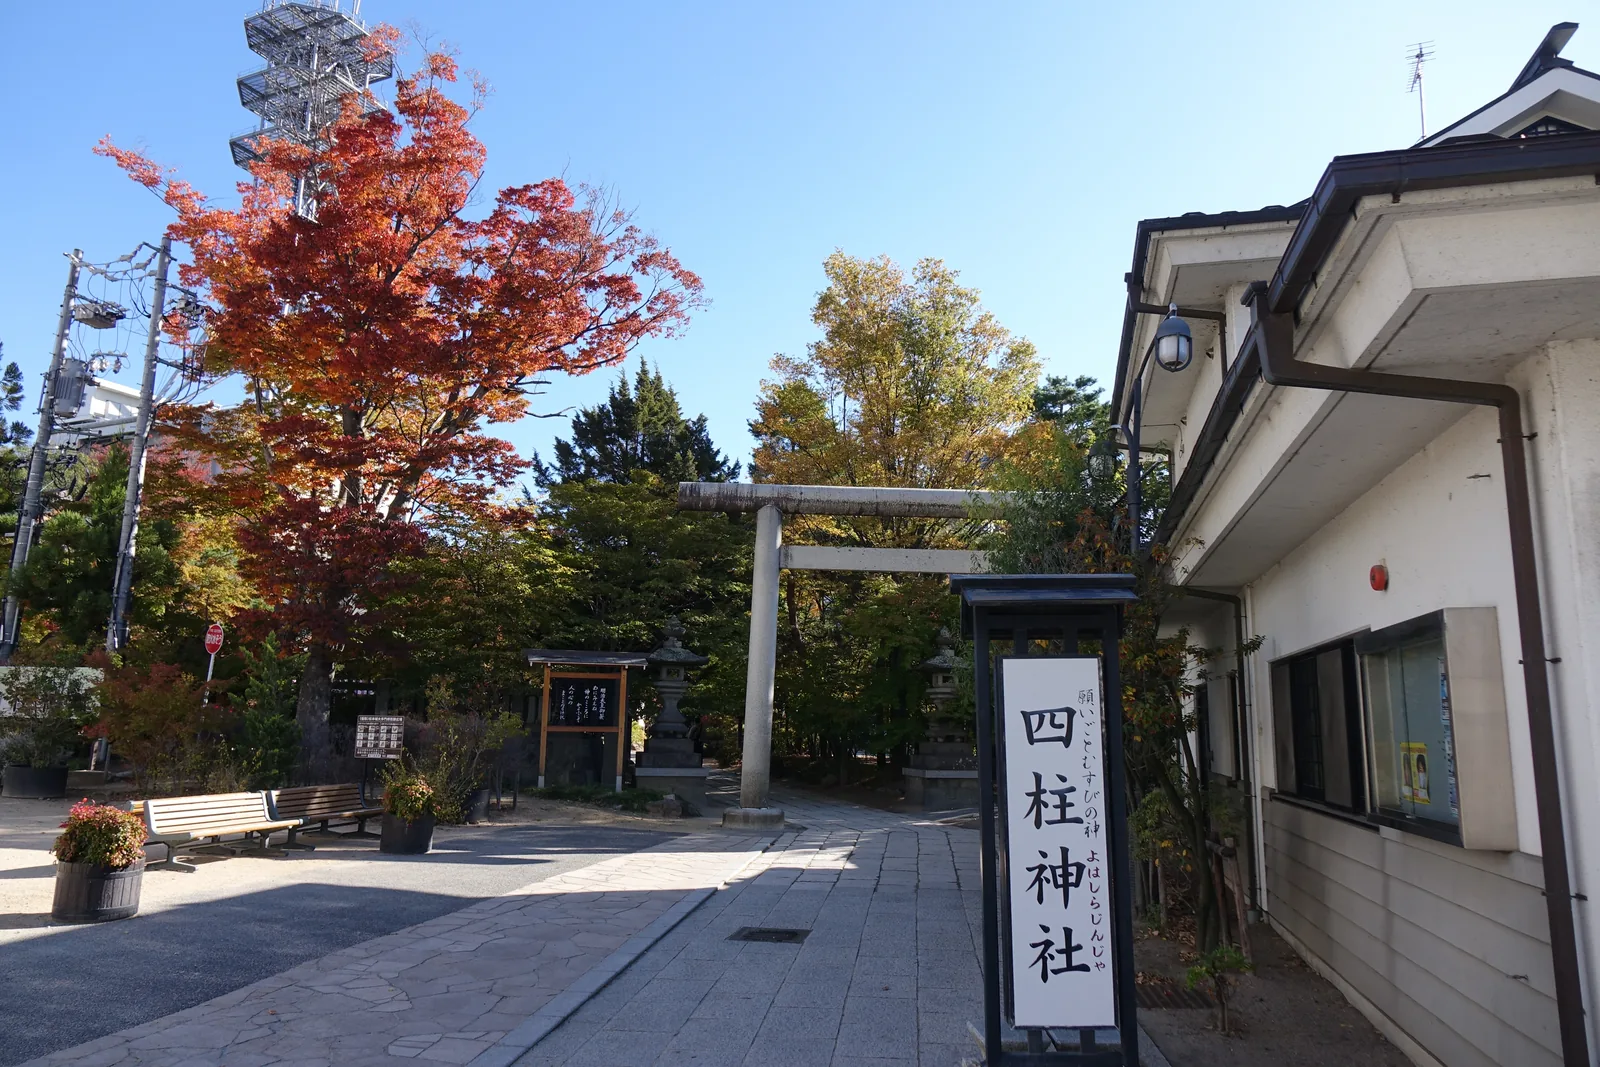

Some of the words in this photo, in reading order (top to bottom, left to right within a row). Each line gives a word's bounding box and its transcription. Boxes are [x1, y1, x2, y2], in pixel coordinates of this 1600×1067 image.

[1020, 706, 1091, 984] 四柱神社
[1077, 688, 1101, 839] 願いごとむすびの神
